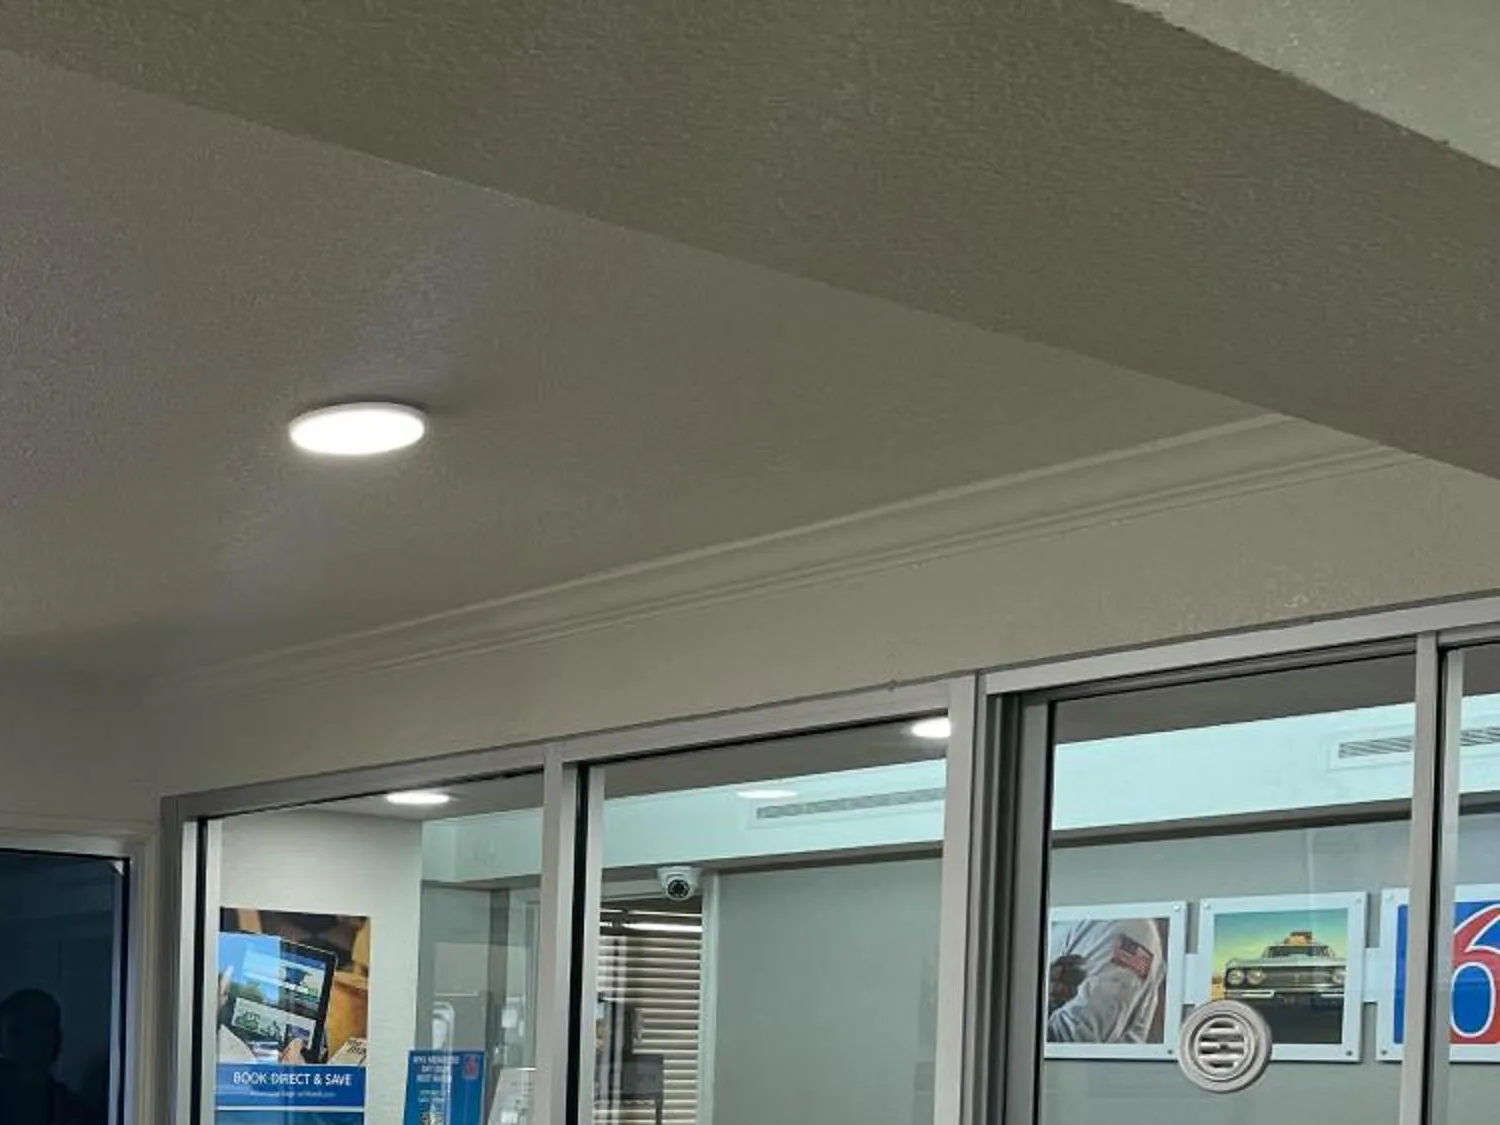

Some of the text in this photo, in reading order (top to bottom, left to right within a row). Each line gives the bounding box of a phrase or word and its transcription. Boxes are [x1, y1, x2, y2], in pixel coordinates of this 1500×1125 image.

[233, 1071, 353, 1087] BOOK DIRECT & SAVE
